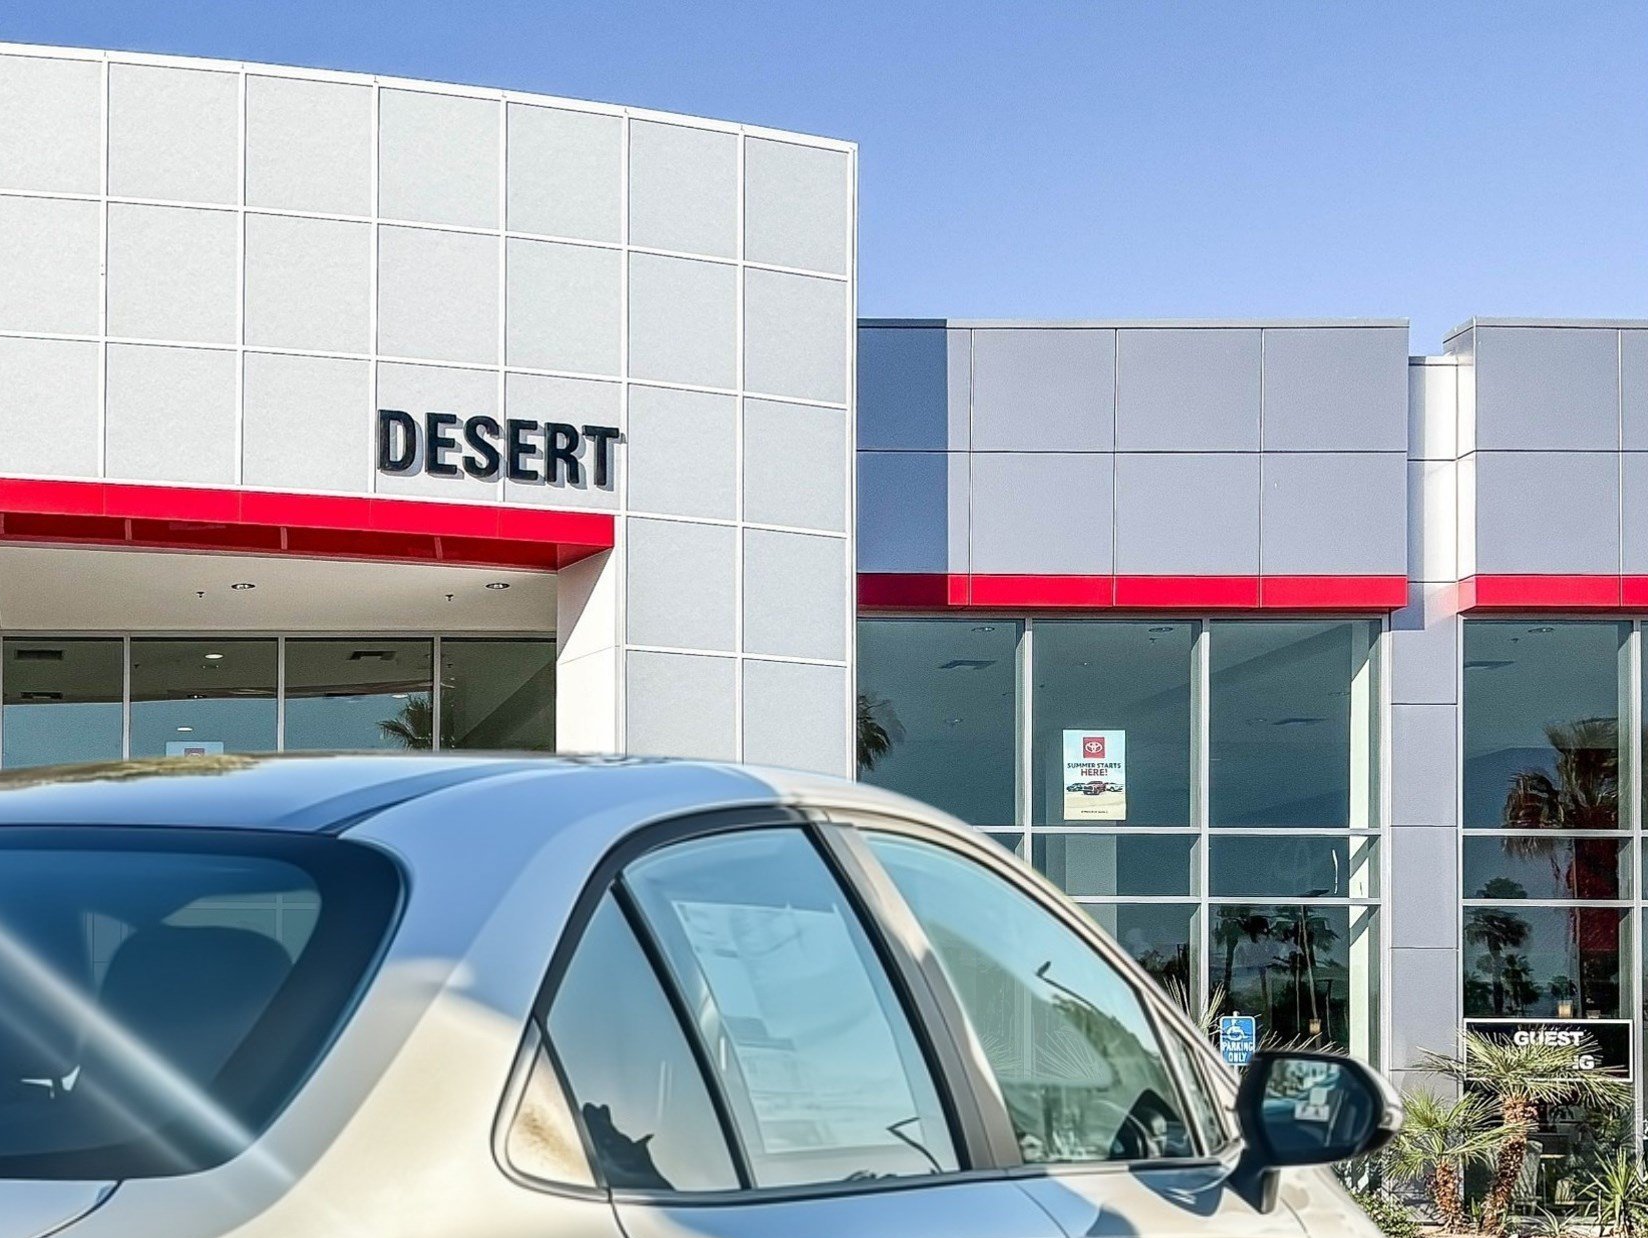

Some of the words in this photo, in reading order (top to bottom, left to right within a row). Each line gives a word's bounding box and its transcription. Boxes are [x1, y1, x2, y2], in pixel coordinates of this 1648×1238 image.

[377, 409, 620, 486] DESERT
[1513, 1031, 1584, 1047] GUEST
[1222, 1041, 1253, 1051] PARKING
[1228, 1052, 1247, 1062] ONLY
